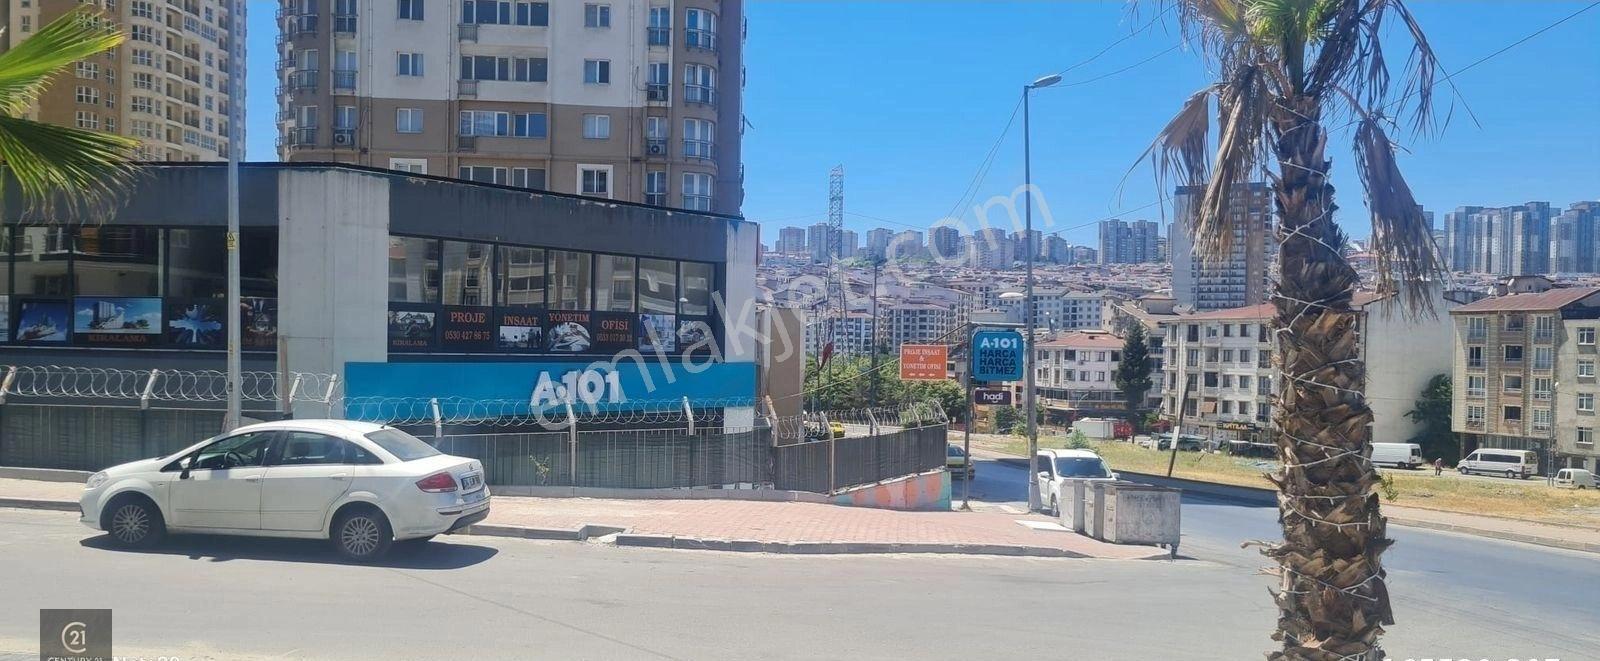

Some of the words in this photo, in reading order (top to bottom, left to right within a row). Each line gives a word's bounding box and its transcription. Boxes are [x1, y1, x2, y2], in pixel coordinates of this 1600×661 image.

[450, 312, 486, 323] PROJE
[980, 350, 1017, 358] HARCA
[980, 358, 1017, 367] HARCA
[983, 392, 1004, 401] hadi
